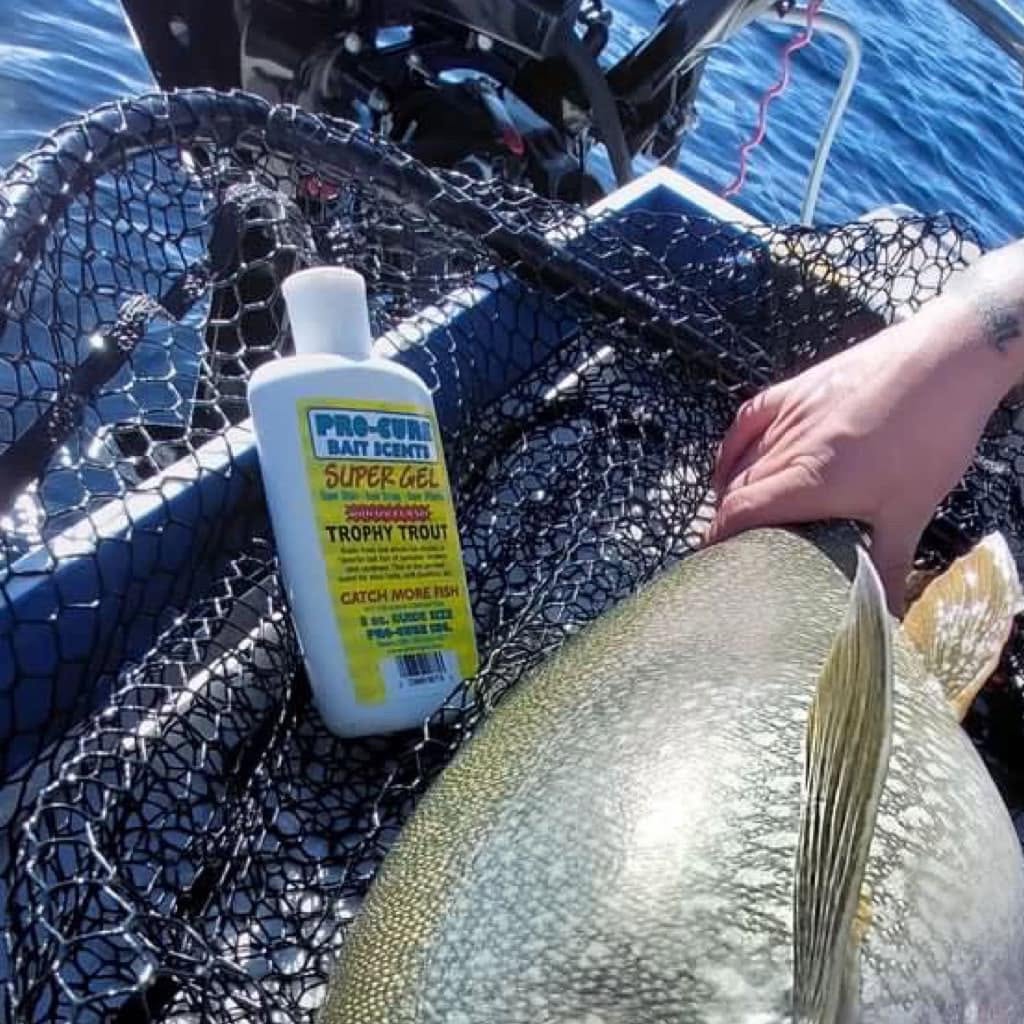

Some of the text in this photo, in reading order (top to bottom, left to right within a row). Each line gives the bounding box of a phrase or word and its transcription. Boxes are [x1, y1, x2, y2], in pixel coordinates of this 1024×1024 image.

[327, 440, 368, 455] BAIT
[325, 463, 440, 489] SUPER GEL
[325, 524, 448, 542] TROPHY TROUT
[340, 589, 388, 605] CATCH
[392, 586, 431, 601] MORE
